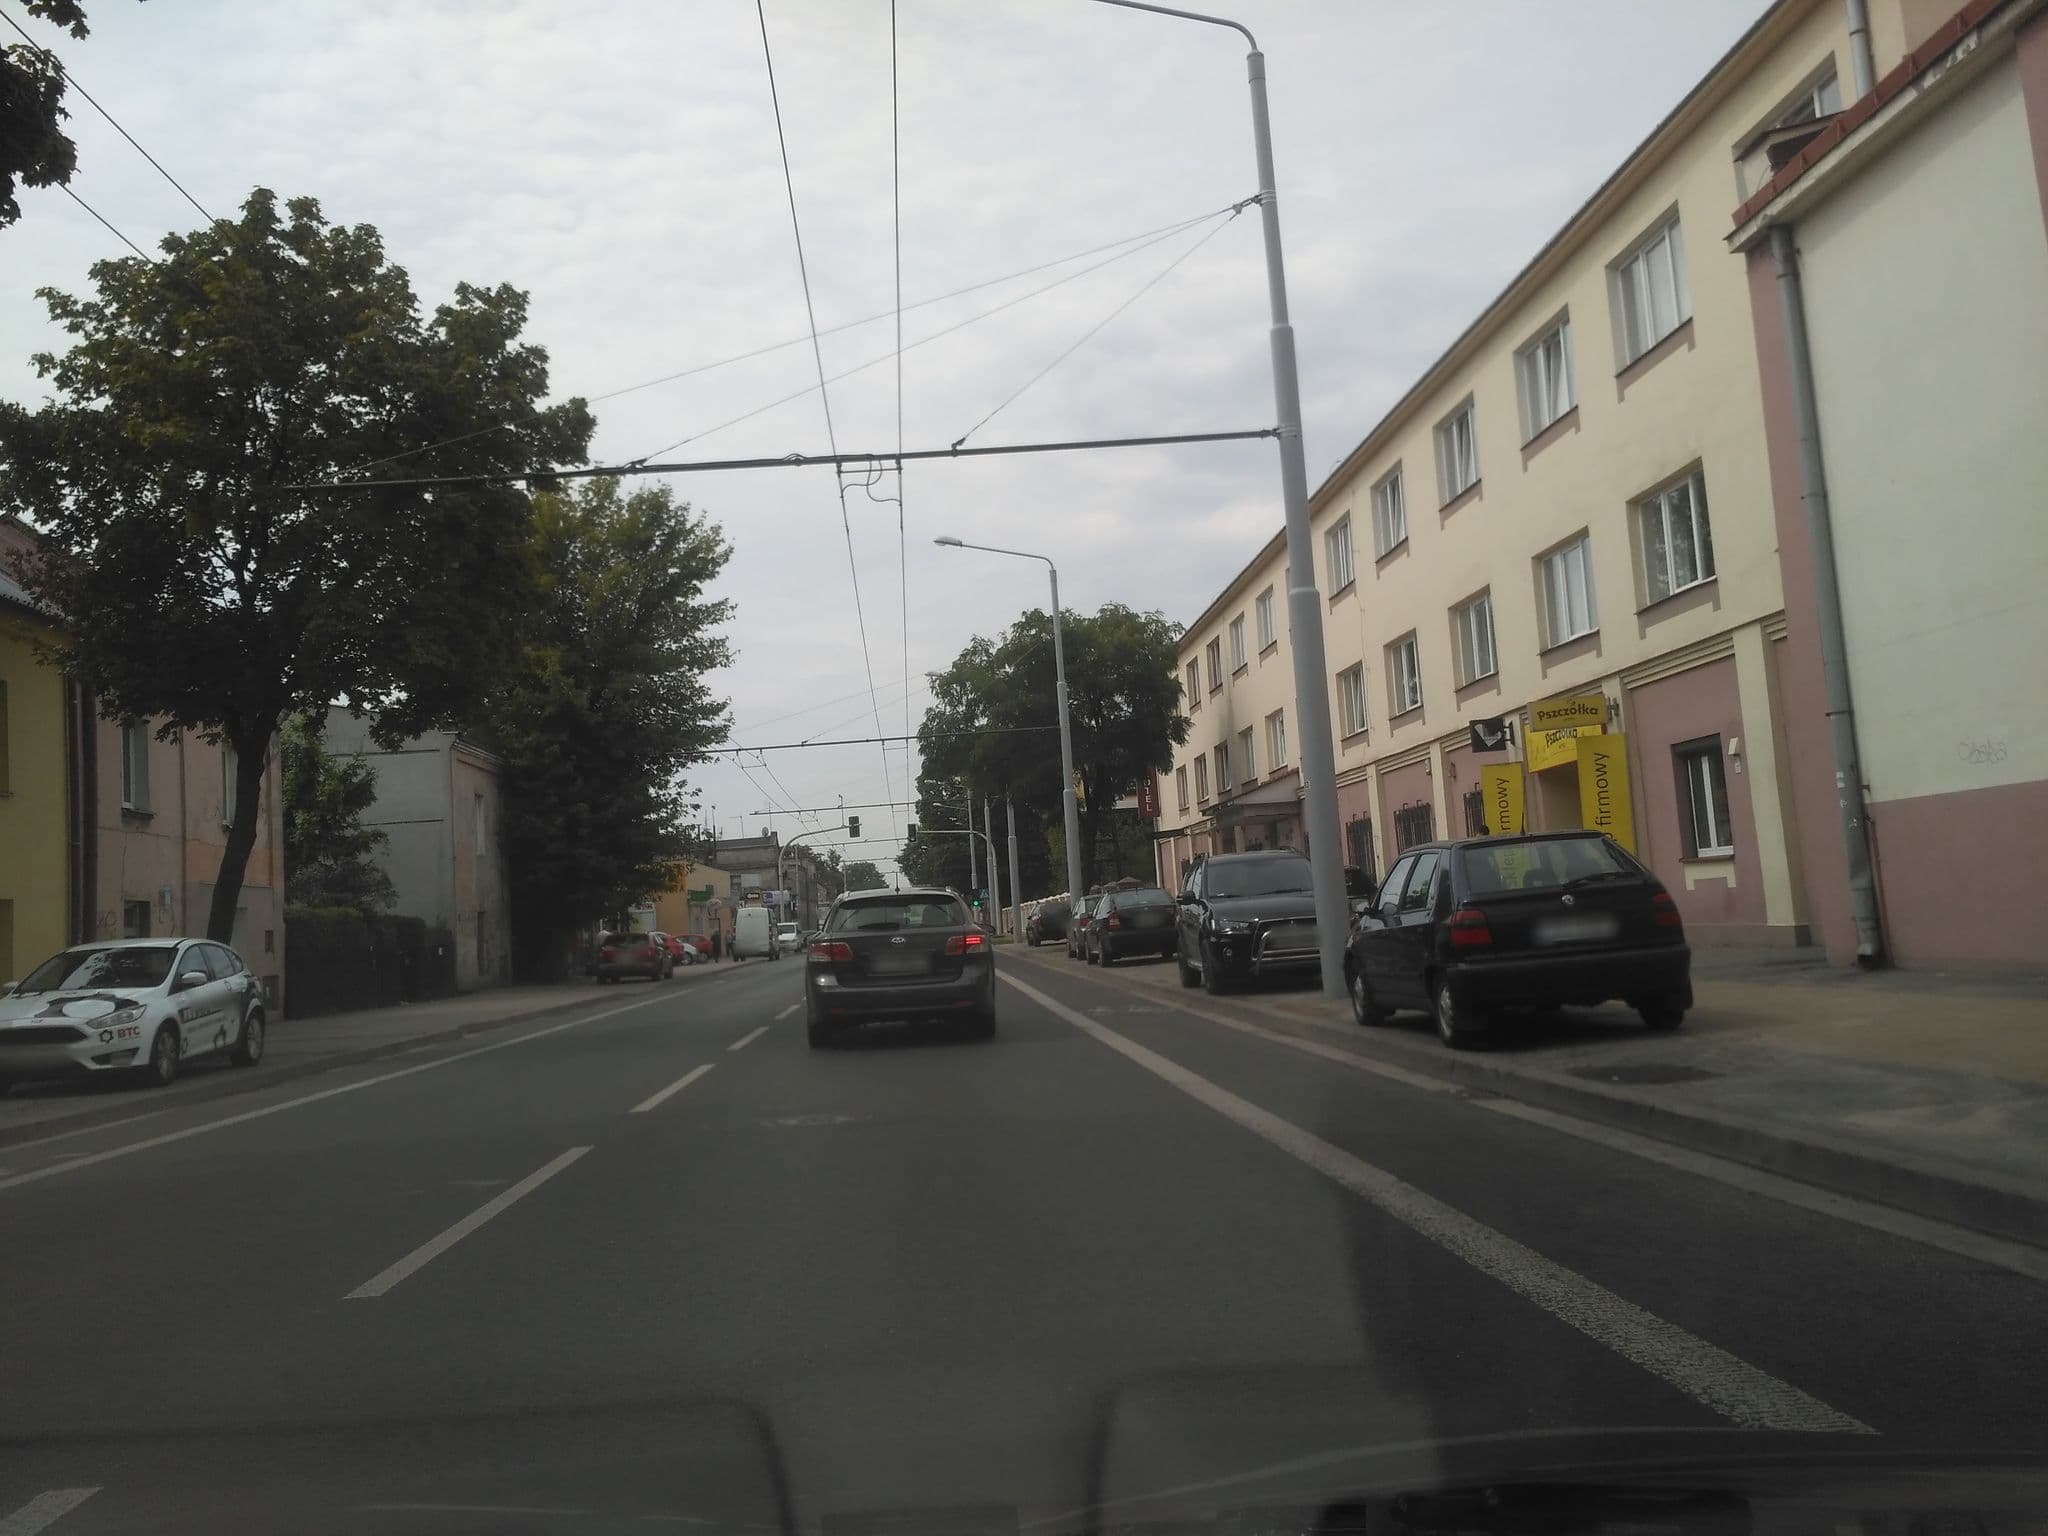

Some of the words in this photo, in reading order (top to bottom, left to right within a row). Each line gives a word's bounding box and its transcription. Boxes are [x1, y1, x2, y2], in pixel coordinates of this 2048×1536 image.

[1537, 704, 1598, 720] Pszczółka
[1143, 775, 1153, 812] OTEL
[1495, 777, 1512, 832] rmowy
[1593, 752, 1612, 827] firmowy
[117, 1026, 141, 1038] BTC
